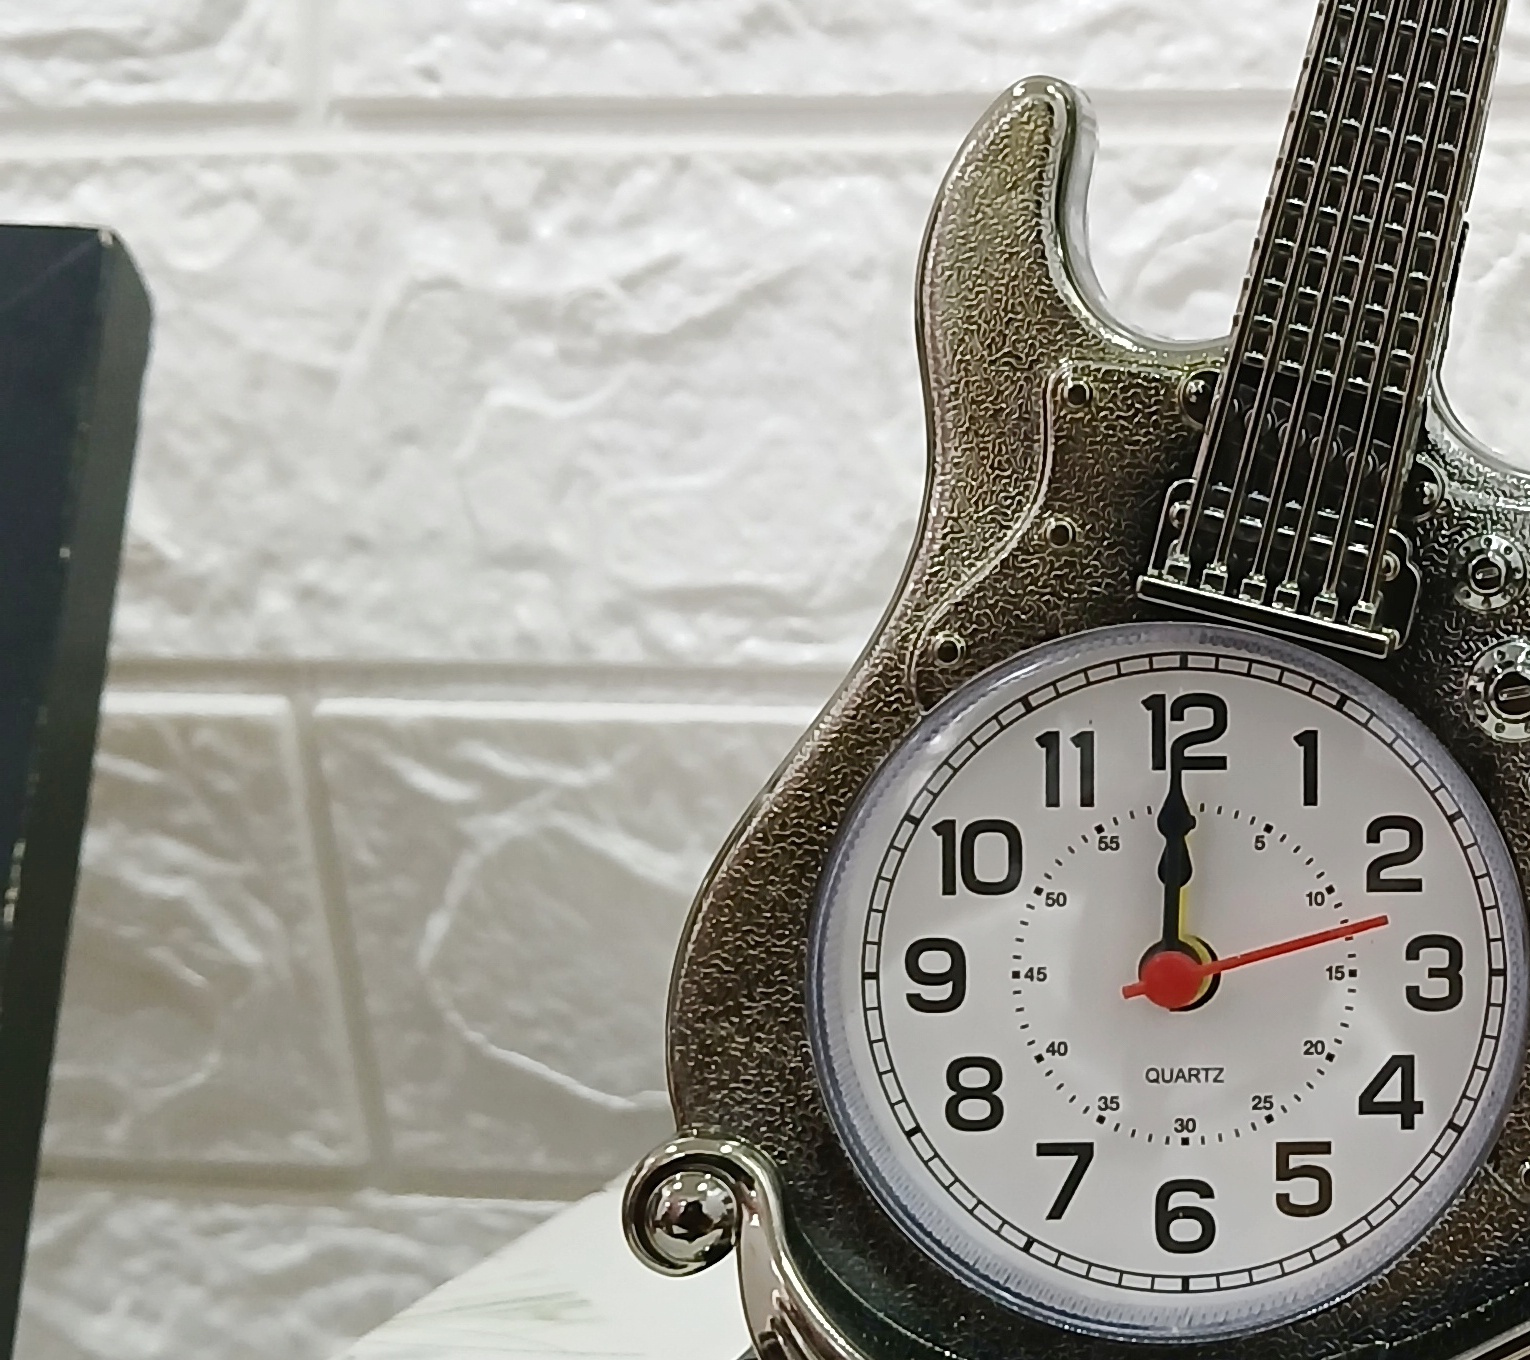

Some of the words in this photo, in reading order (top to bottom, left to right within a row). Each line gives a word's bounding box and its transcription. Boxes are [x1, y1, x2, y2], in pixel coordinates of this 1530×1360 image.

[1141, 693, 1227, 771] 12
[1035, 731, 1094, 807] 11
[1293, 730, 1318, 806] 1
[932, 819, 1022, 895] 10
[1096, 832, 1121, 852] 55
[1254, 834, 1266, 851] 5
[1366, 815, 1423, 892] 2
[1044, 891, 1068, 908] 50
[1305, 887, 1327, 907] 10
[905, 938, 966, 1013] 9
[1023, 966, 1048, 983] 45
[1325, 964, 1346, 981] 15
[1406, 934, 1463, 1012] 3
[1045, 1041, 1069, 1057] 40
[1303, 1039, 1326, 1056] 20
[945, 1056, 1004, 1132] 8
[1145, 1067, 1225, 1085] QUARTZ
[1359, 1055, 1423, 1130] 4
[1097, 1095, 1120, 1112] 35
[1173, 1117, 1197, 1134] 30
[1251, 1094, 1274, 1111] 25
[1036, 1142, 1094, 1220] 7
[1276, 1141, 1332, 1217] 5
[1155, 1179, 1216, 1254] 6
